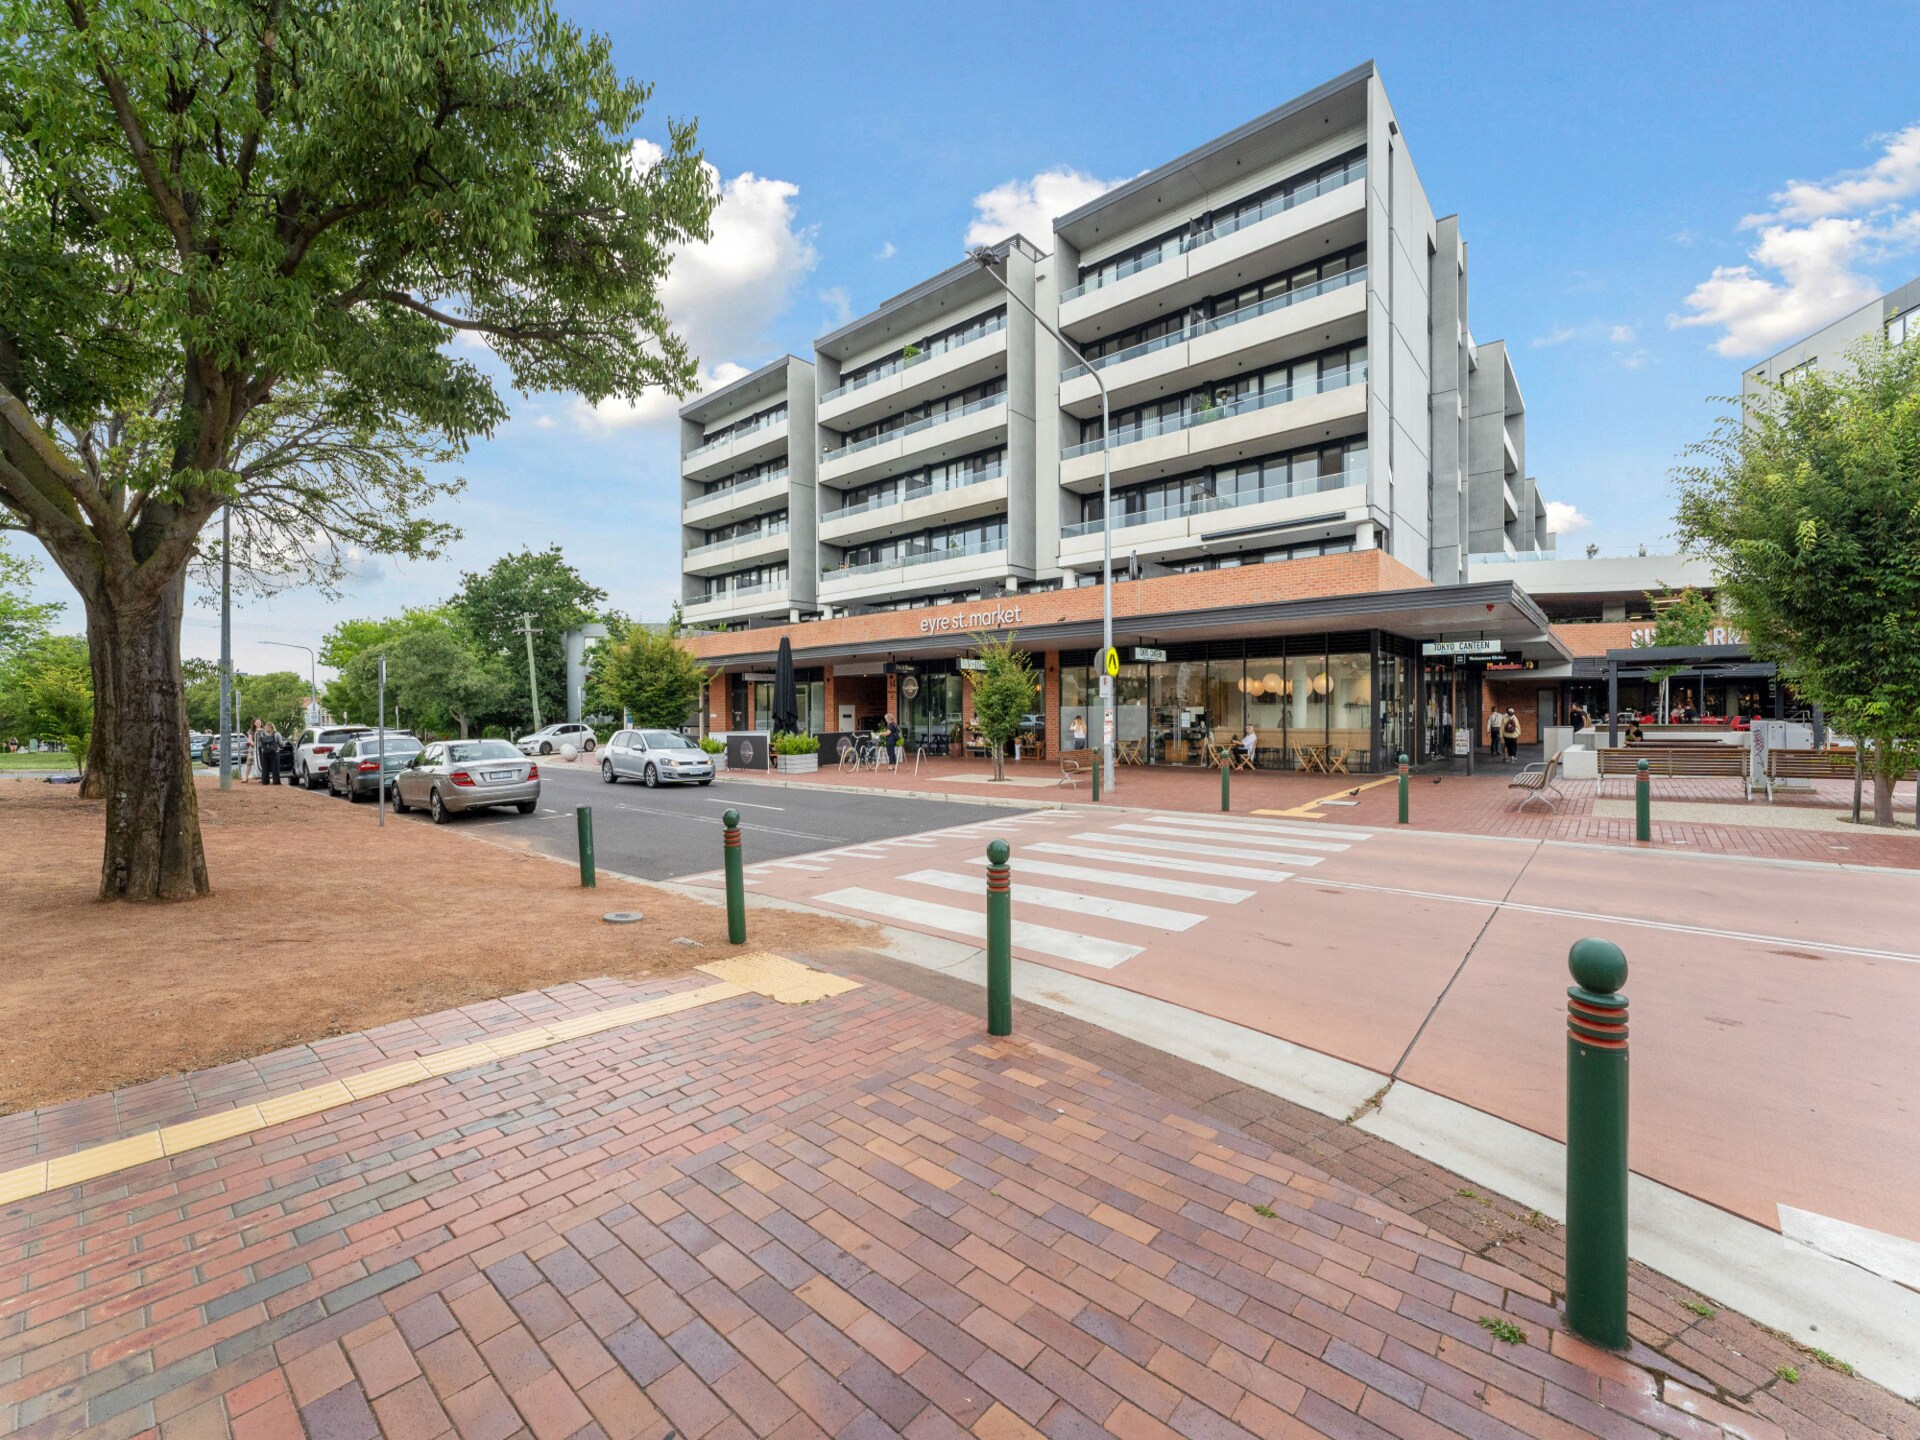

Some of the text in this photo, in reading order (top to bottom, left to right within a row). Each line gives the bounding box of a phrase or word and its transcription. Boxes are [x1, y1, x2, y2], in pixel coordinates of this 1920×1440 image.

[920, 604, 1021, 635] eyre st. market
[1434, 641, 1490, 651] TOKYO CANTEEN
